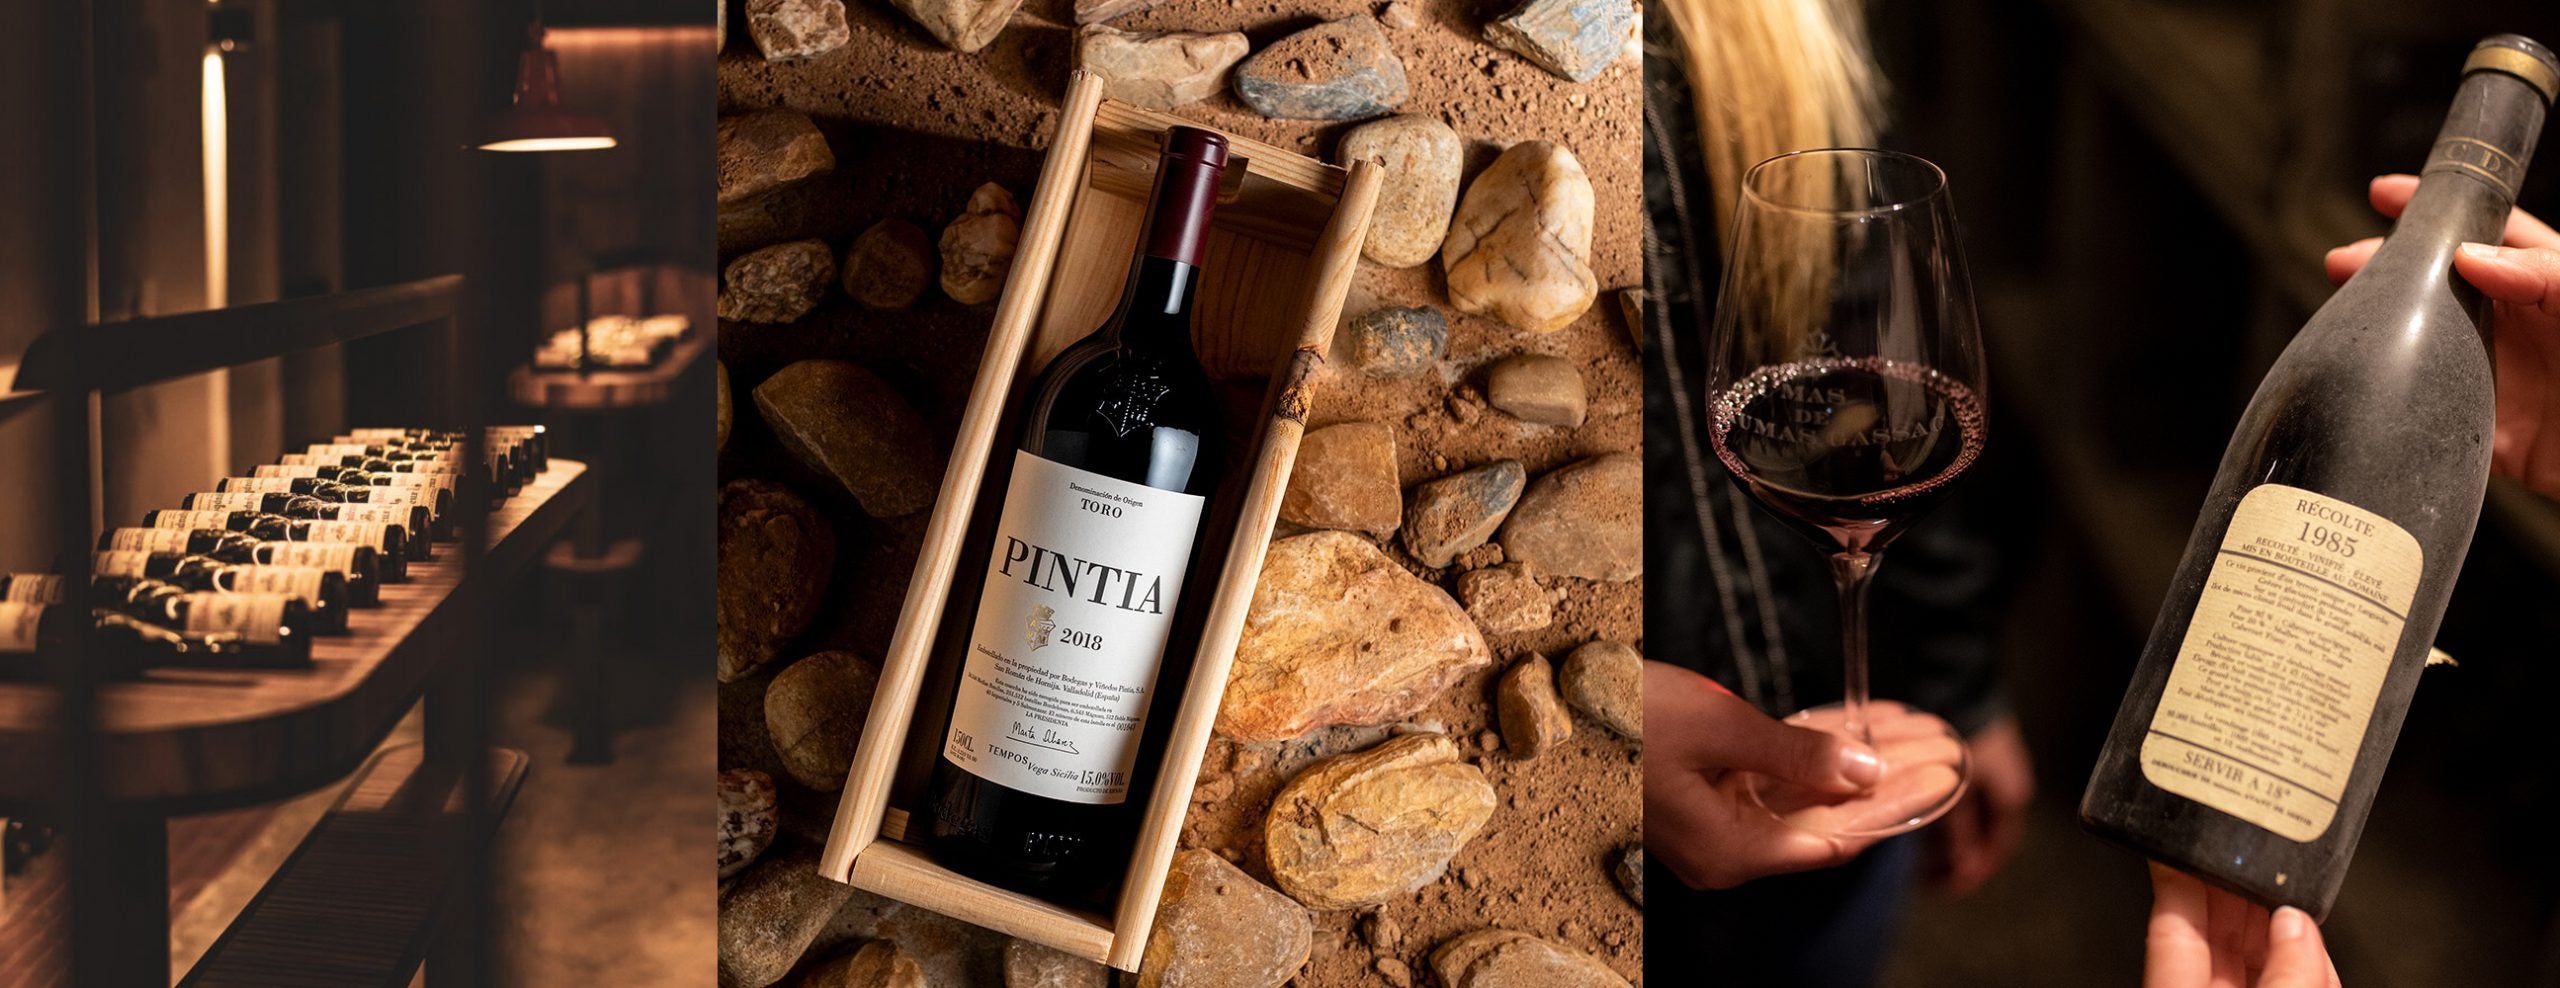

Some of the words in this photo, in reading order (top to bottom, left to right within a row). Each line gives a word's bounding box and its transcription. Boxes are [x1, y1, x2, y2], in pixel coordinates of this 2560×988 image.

[1780, 383, 1847, 406] MAS
[1794, 408, 1830, 426] DE
[1069, 482, 1112, 500] Denominación
[1114, 495, 1121, 503] de
[1123, 496, 1143, 507] Origen
[1080, 498, 1122, 518] TORO
[2296, 498, 2375, 537] RÉCOLTE
[2297, 522, 2360, 558] 1985
[998, 535, 1162, 614] PINTIA
[2242, 543, 2256, 552] MIS
[2259, 547, 2271, 557] EN
[2274, 550, 2328, 577] BOUTEILLE
[2333, 572, 2345, 582] AU
[2347, 578, 2388, 603] DOMAINE
[1060, 627, 1103, 651] 2018
[1005, 667, 1025, 680] Román
[1026, 675, 1034, 683] de
[1063, 684, 1094, 697] Valladolid
[1011, 658, 1018, 666] la
[1018, 661, 1048, 677] propiedad
[1049, 671, 1060, 680] por
[1061, 674, 1087, 686] Bodegas
[1034, 712, 1068, 727] PRESIDENTA
[988, 744, 1028, 765] TEMPOS
[1028, 762, 1048, 776] Vega
[1050, 768, 1079, 781] Sicilia
[2182, 751, 2245, 783] SERVIR
[2249, 776, 2261, 790] A
